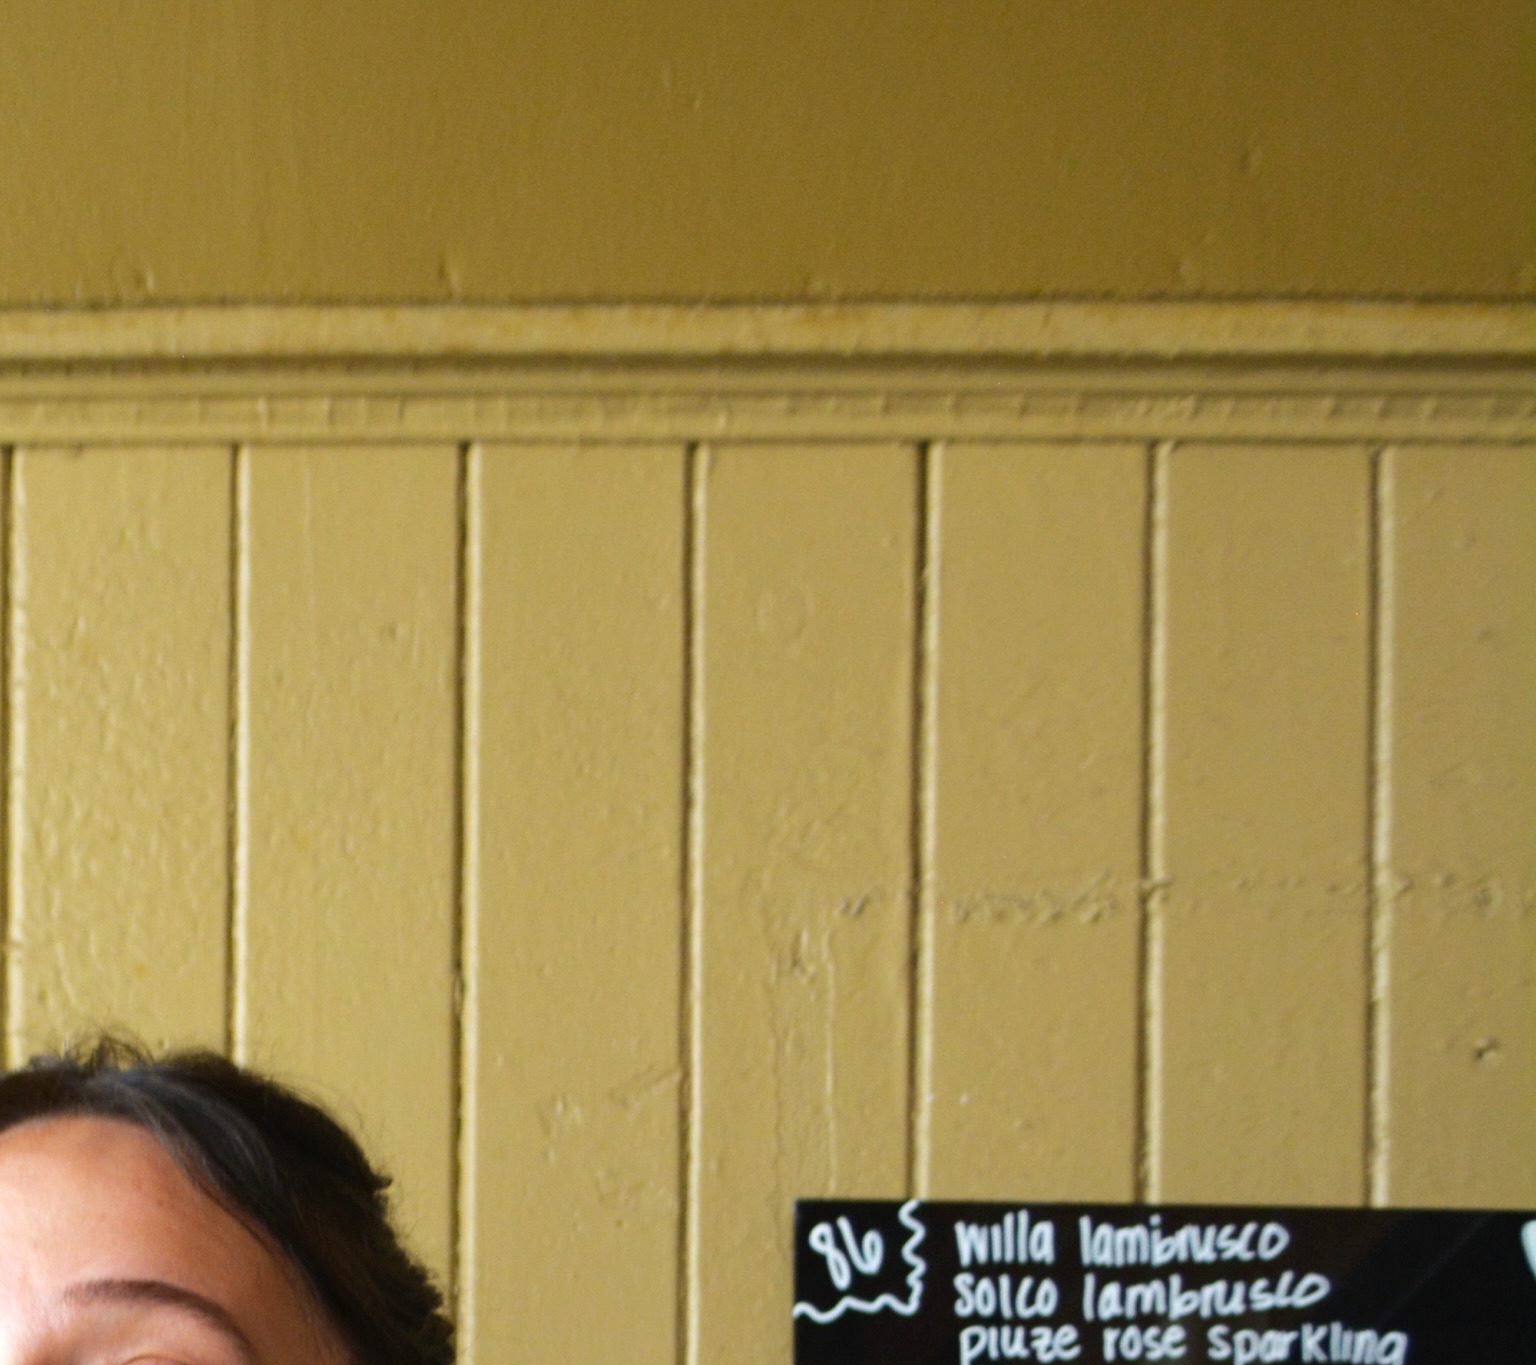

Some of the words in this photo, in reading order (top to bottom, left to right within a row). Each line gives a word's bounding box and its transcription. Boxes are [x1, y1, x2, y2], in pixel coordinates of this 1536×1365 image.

[808, 1216, 884, 1290] 86
[953, 1272, 1058, 1319] solco
[1082, 1272, 1330, 1321] lambrusco
[1103, 1323, 1187, 1362] rose
